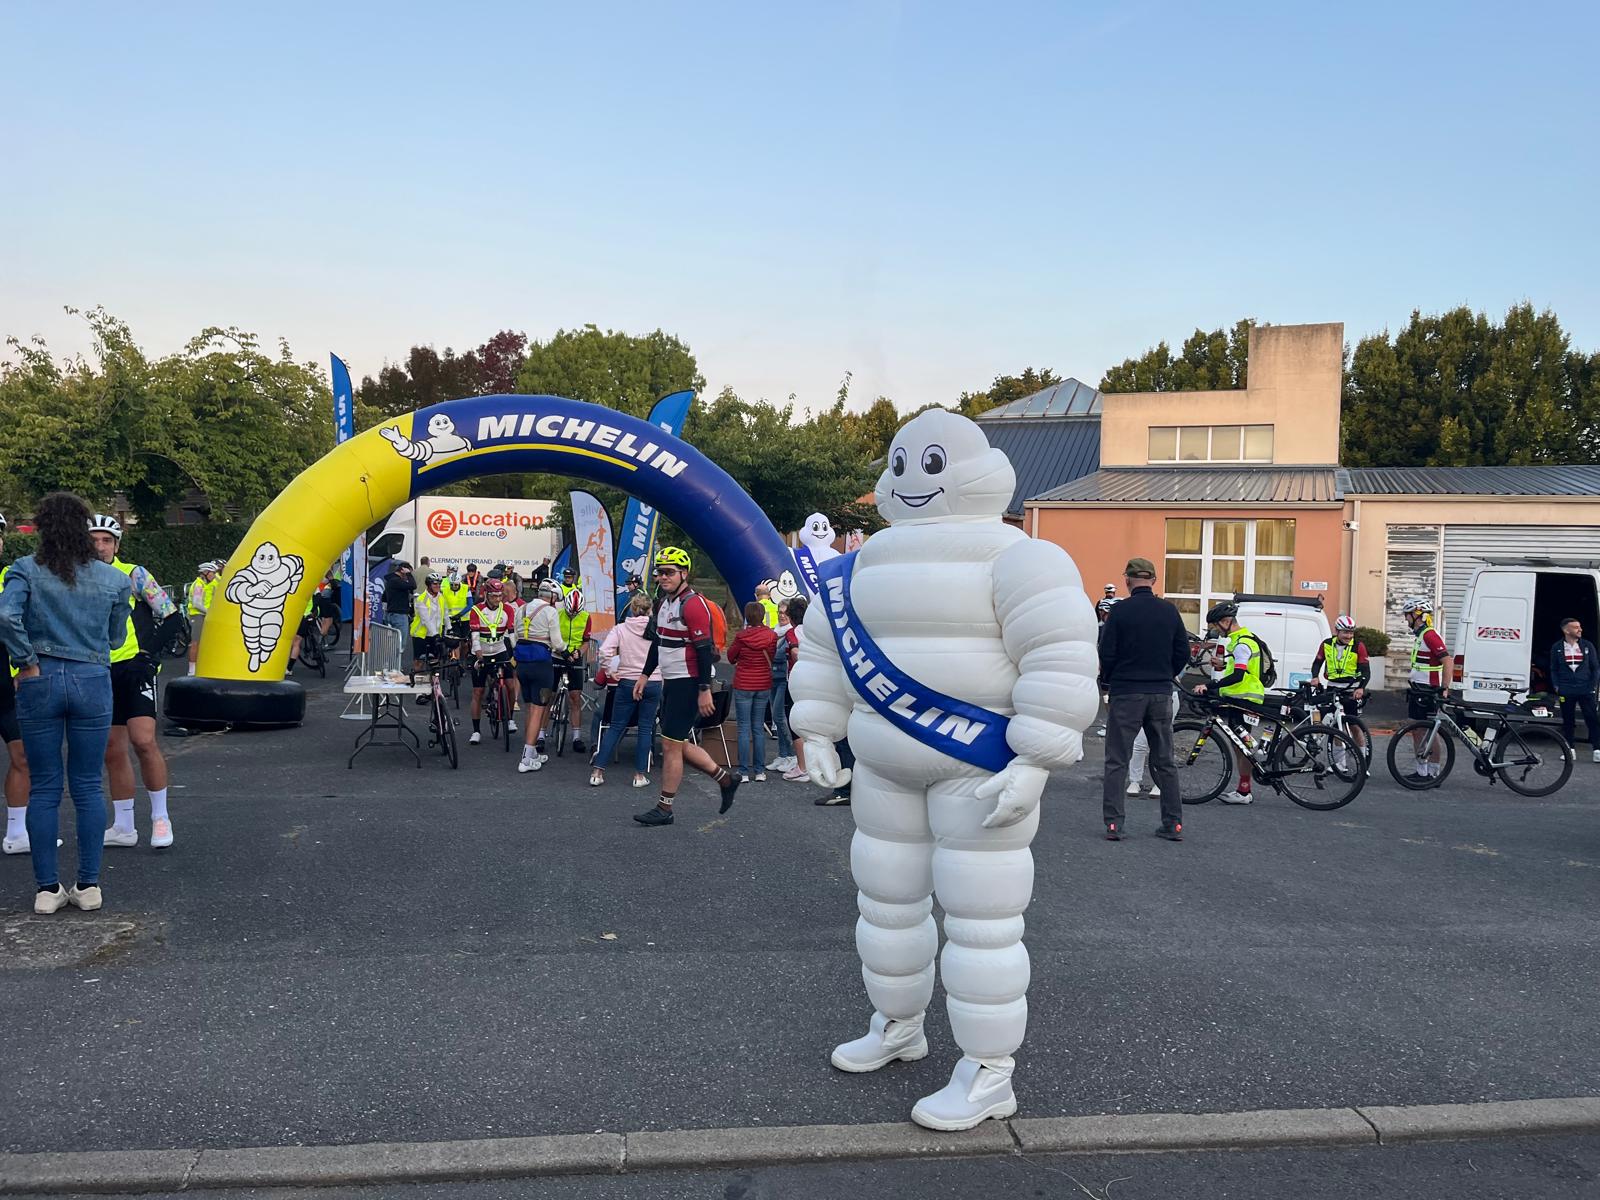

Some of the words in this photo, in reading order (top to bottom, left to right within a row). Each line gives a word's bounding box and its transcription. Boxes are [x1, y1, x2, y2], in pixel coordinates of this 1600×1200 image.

[477, 414, 688, 478] MICHELIN
[459, 511, 544, 527] Location
[458, 529, 495, 537] E.Leclerc
[1485, 629, 1514, 637] SERVICE
[825, 576, 987, 746] MICHELIN
